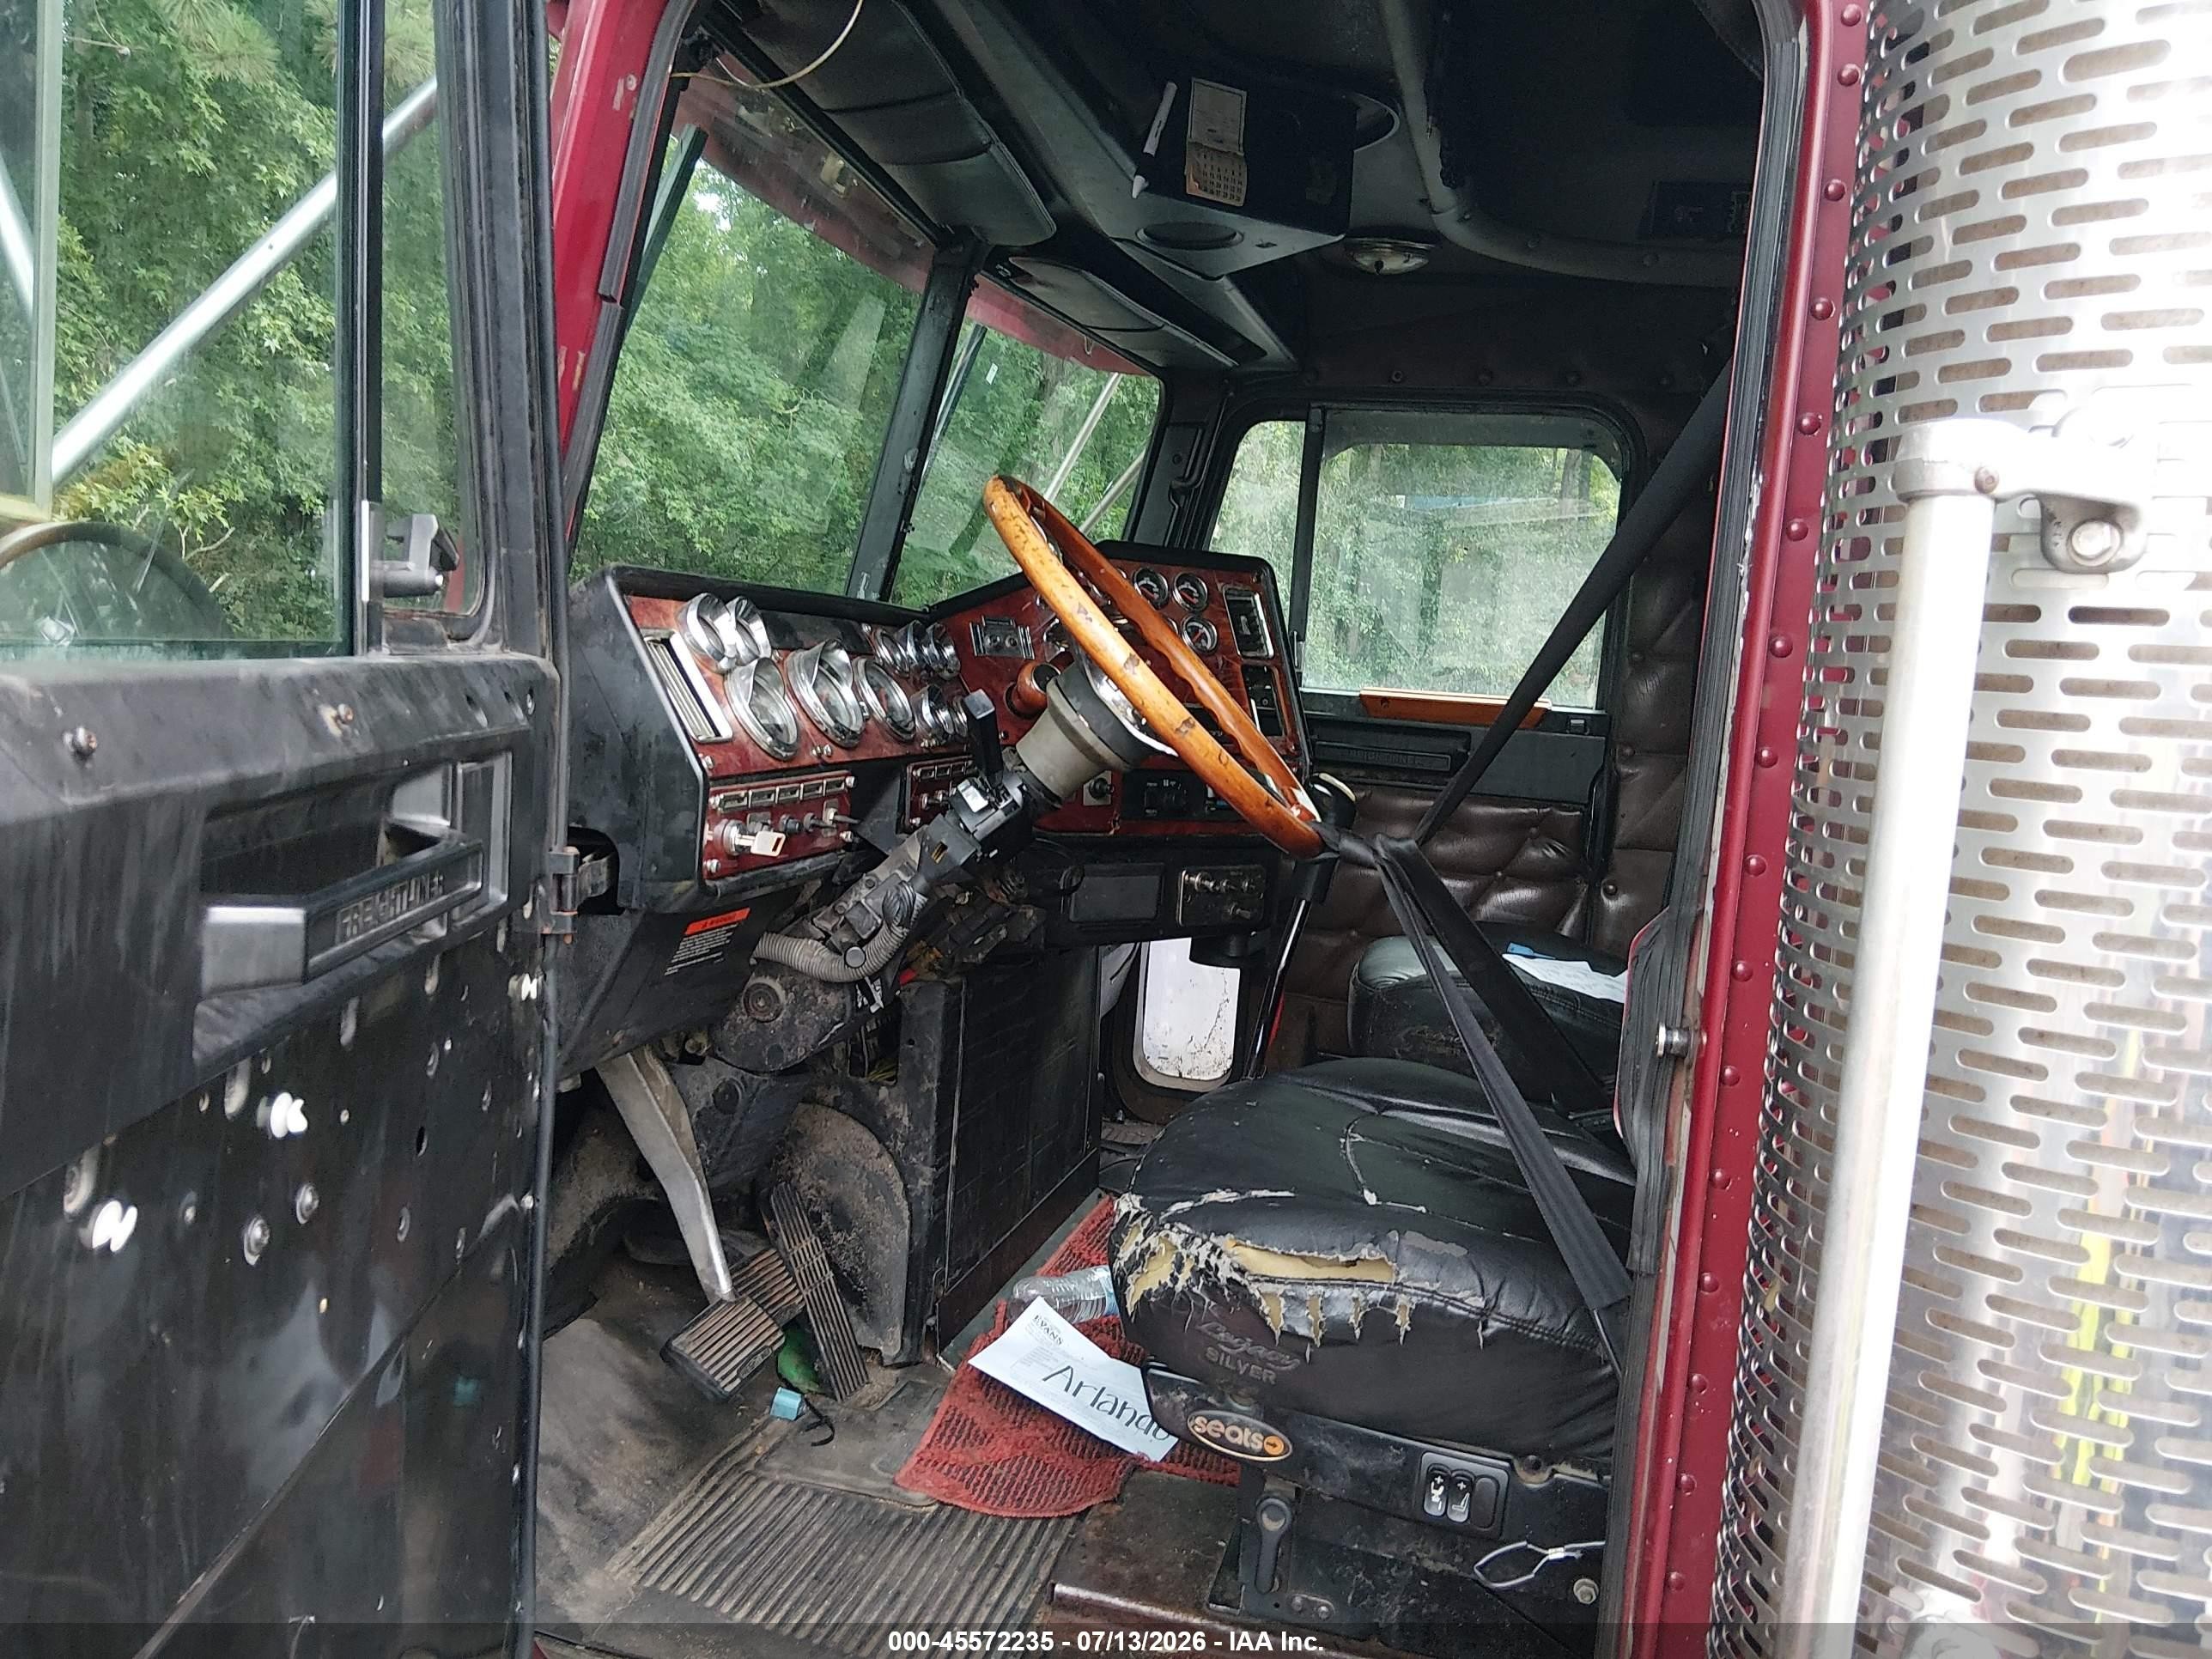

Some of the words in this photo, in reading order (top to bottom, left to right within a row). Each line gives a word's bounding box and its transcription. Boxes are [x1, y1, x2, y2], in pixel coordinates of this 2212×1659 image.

[1033, 1314, 1064, 1346] EVANS
[1205, 1346, 1278, 1385] SILVER
[1193, 1415, 1265, 1453] seats
